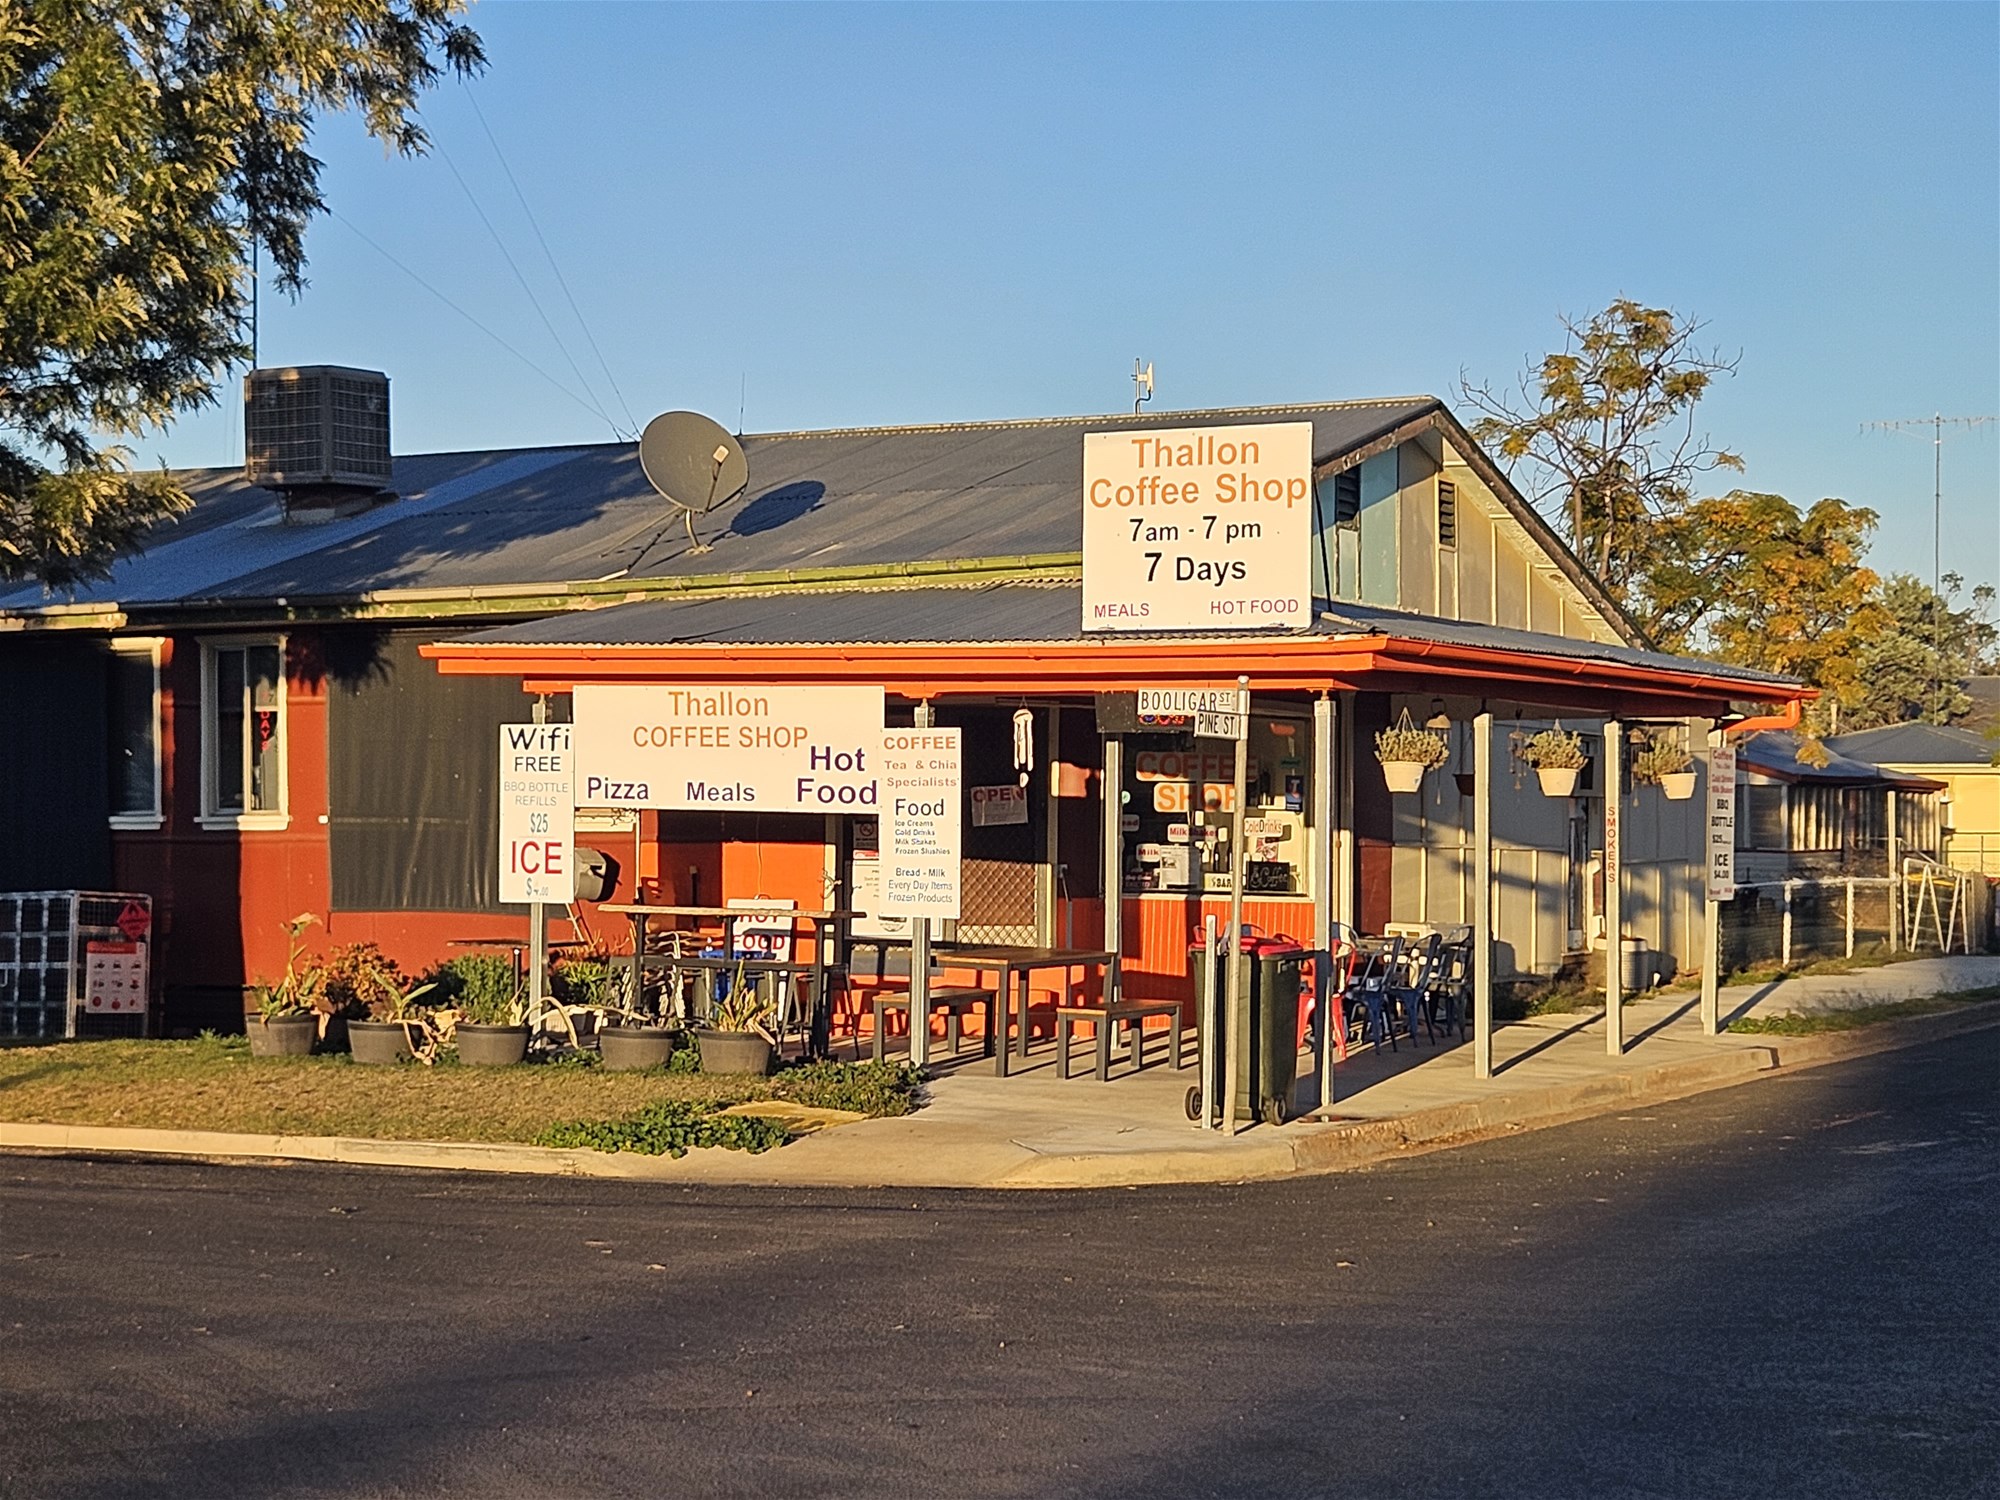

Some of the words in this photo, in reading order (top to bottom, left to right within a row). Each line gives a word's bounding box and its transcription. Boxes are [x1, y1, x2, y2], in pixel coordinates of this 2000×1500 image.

[1131, 435, 1259, 468] Thallon
[1089, 475, 1200, 508] Coffee
[1215, 472, 1307, 508] Shop
[1129, 518, 1179, 541] 7am
[1202, 516, 1217, 539] 7
[1226, 522, 1261, 544] pm
[1144, 552, 1162, 582] 7
[1175, 557, 1246, 587] Days
[1094, 602, 1150, 618] MEALS
[1210, 600, 1246, 615] HOT
[1250, 599, 1299, 614] FOOD
[668, 691, 769, 717] Thallon
[1141, 691, 1217, 711] BOOLIGAR
[1219, 692, 1231, 703] ST
[1197, 713, 1219, 734] PINE
[1223, 716, 1235, 735] ST
[508, 727, 570, 751] Wifi
[633, 726, 730, 748] COFFEE
[738, 726, 808, 749] SHOP
[883, 736, 956, 750] COFFEE
[810, 745, 866, 772] Hot
[1713, 750, 1733, 761] Coffee
[514, 756, 561, 772] FREE
[884, 760, 907, 770] Tea
[915, 760, 925, 770] &
[1137, 753, 1259, 780] COFFEE
[503, 781, 526, 792] BBQ
[528, 781, 569, 793] BOTTLE
[587, 777, 649, 800] Pizza
[686, 781, 756, 802] Meals
[887, 777, 957, 789] Specialists
[797, 778, 878, 805] Food
[972, 787, 1025, 803] OPEN
[515, 795, 557, 807] REFILLS
[895, 798, 944, 816] Food
[1717, 798, 1729, 810] BBQ
[530, 812, 549, 834] $25
[1711, 815, 1733, 828] BOTTLE
[1169, 827, 1187, 836] Milk
[911, 838, 937, 846] Shakes
[1607, 806, 1616, 883] SMOKERS
[511, 841, 563, 875] ICE
[1138, 848, 1159, 856] Milk
[1714, 853, 1729, 867] ICE
[895, 868, 921, 877] Bread
[928, 868, 946, 878] Milk
[888, 879, 911, 891] Every
[913, 880, 929, 892] Day
[888, 892, 916, 902] Frozen
[918, 892, 953, 903] Products
